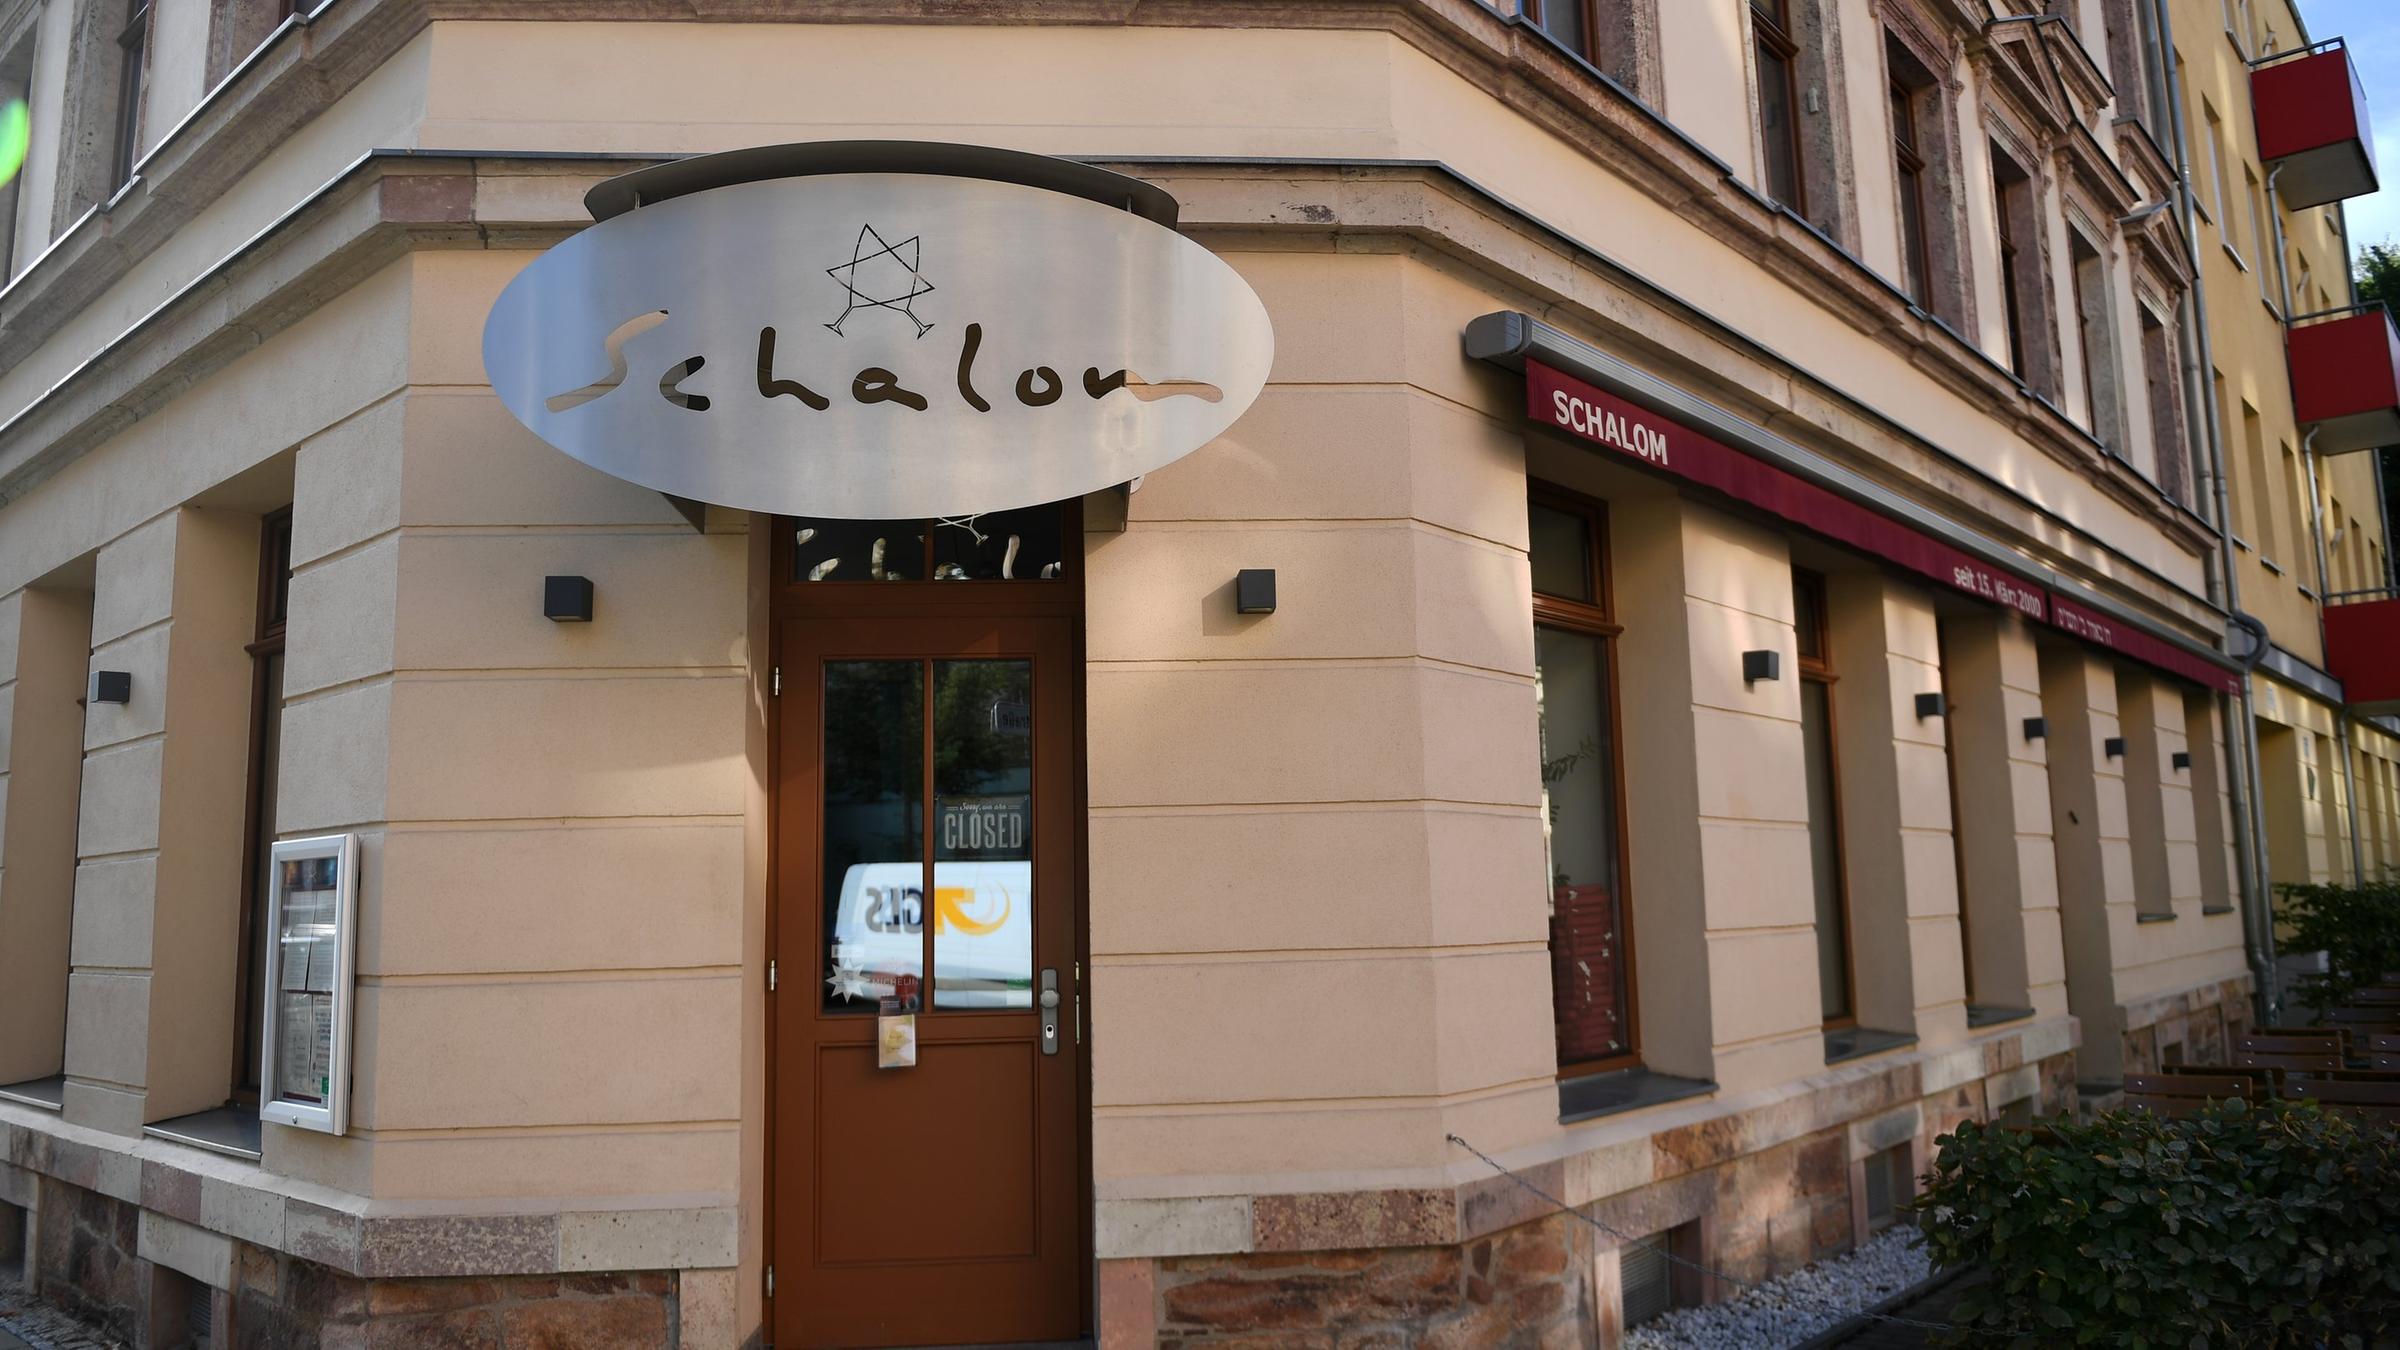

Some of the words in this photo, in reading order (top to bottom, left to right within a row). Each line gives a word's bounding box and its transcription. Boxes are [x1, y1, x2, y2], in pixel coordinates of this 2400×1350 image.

[546, 309, 1224, 413] Schalom
[1553, 390, 1668, 465] SCHALOM
[1953, 566, 1976, 591] seit
[1977, 571, 1993, 598] 15.
[2017, 588, 2042, 618] 2000
[944, 813, 1022, 849] CLOSED
